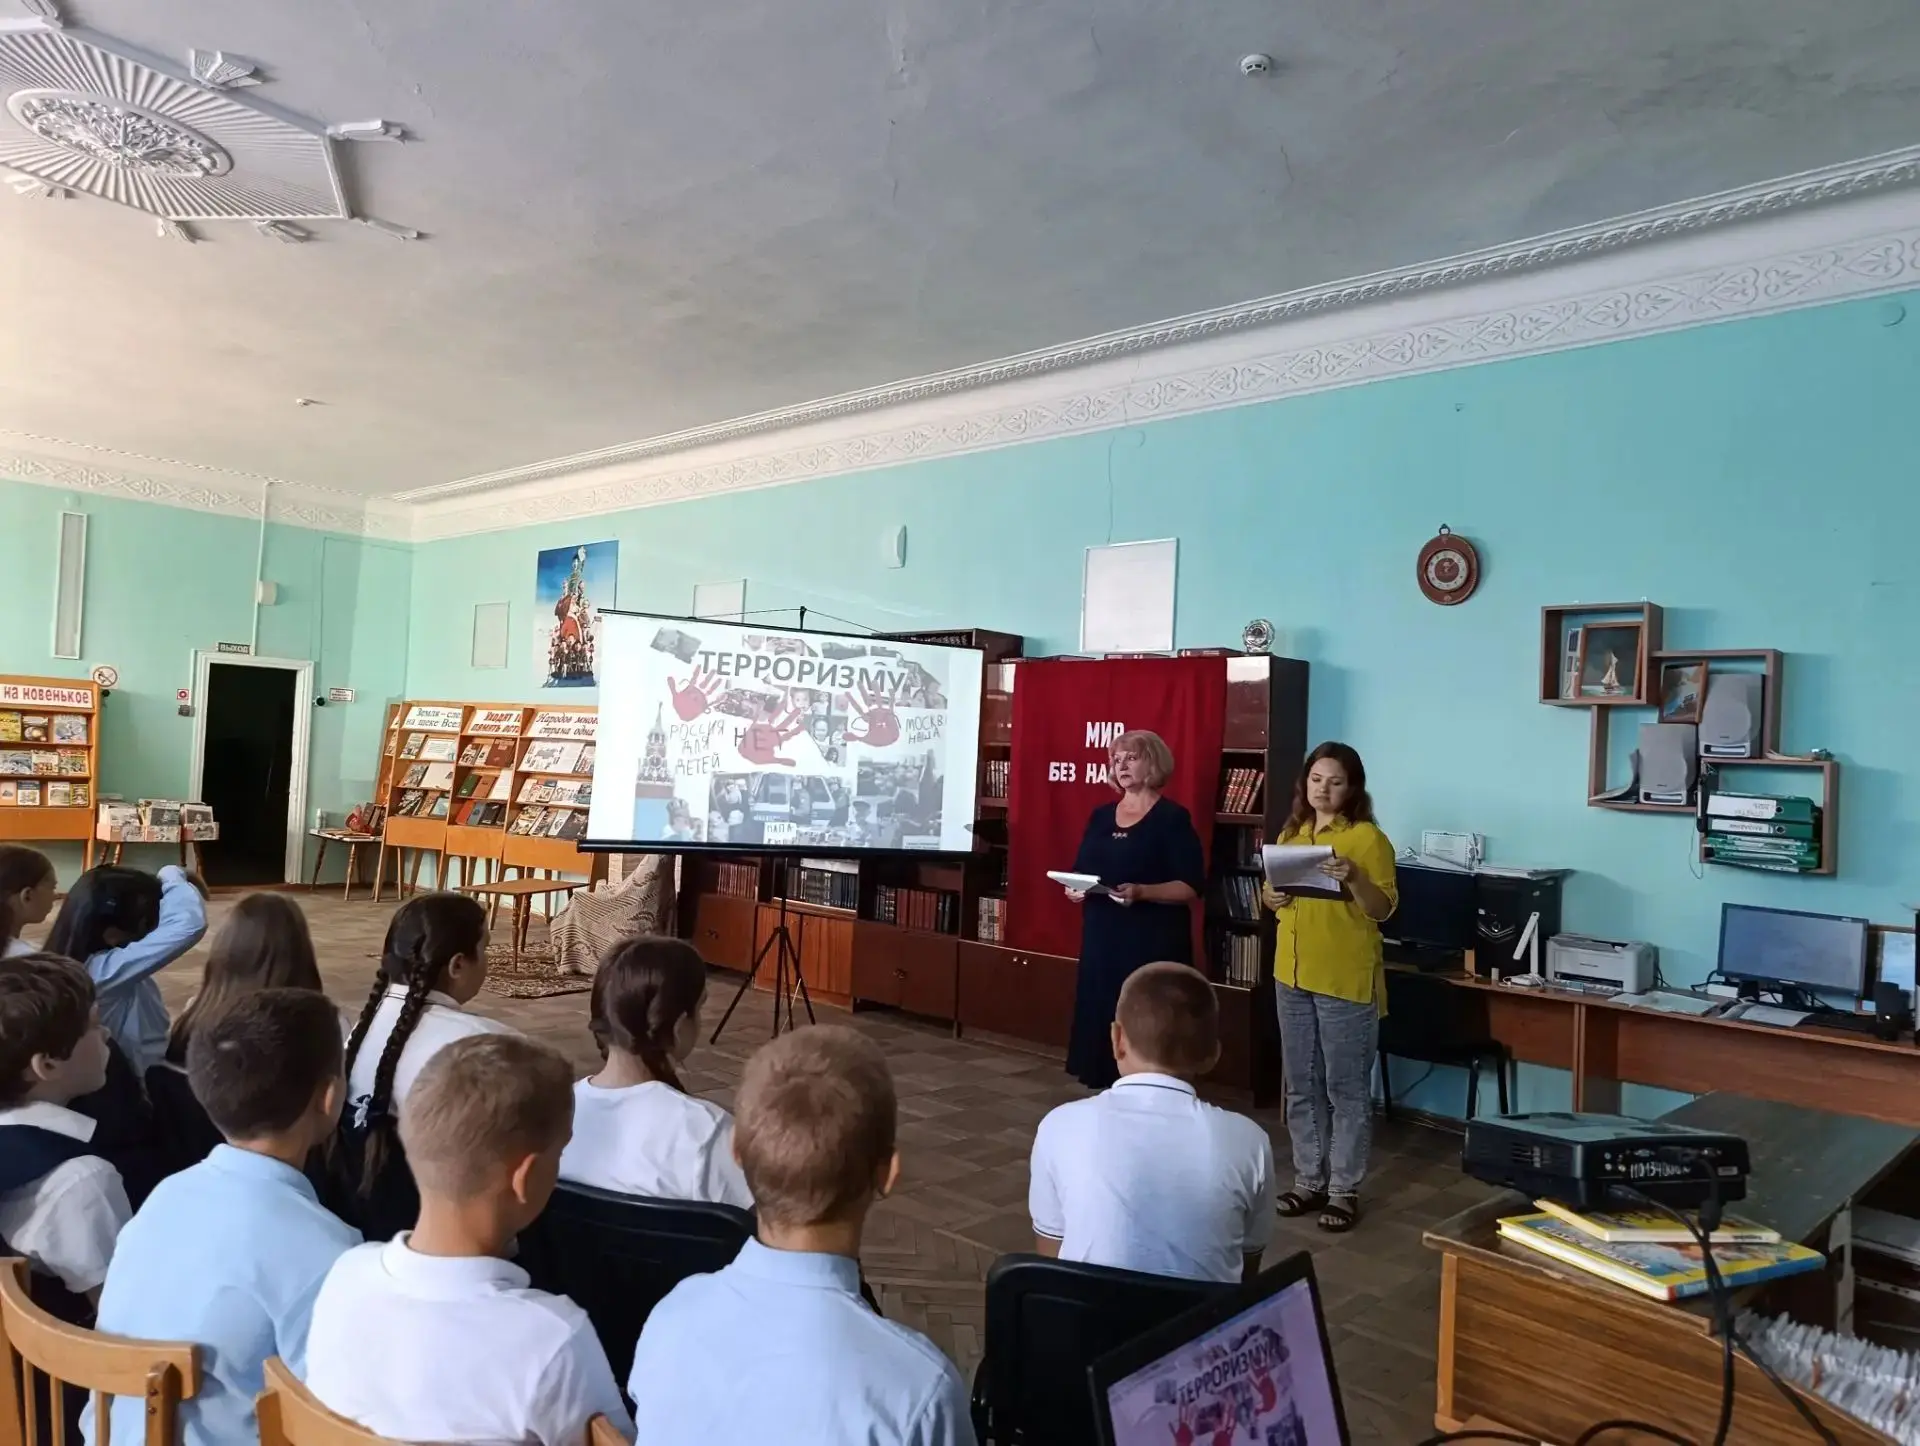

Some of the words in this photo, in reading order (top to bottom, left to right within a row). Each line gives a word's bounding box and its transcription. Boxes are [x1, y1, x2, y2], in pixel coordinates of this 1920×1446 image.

[219, 643, 249, 654] ВЫХОД
[698, 650, 906, 693] ТЕРРОРИЗМУ
[3, 686, 19, 699] на
[23, 687, 89, 704] новенькое
[405, 718, 416, 726] на
[416, 708, 440, 717] Земля
[535, 711, 573, 727] Народов
[470, 723, 501, 733] память
[538, 726, 571, 737] страна
[573, 724, 595, 737] одна
[670, 719, 725, 741] РОССИЯ
[1085, 721, 1125, 748] МИР
[682, 735, 709, 755] ДЛЯ
[734, 727, 789, 751] НЕТ
[675, 751, 720, 776] ДЕТЕЙ
[1048, 761, 1077, 782] БЕЗ
[1178, 1341, 1270, 1404] ТЕРРОРИЗМУ
